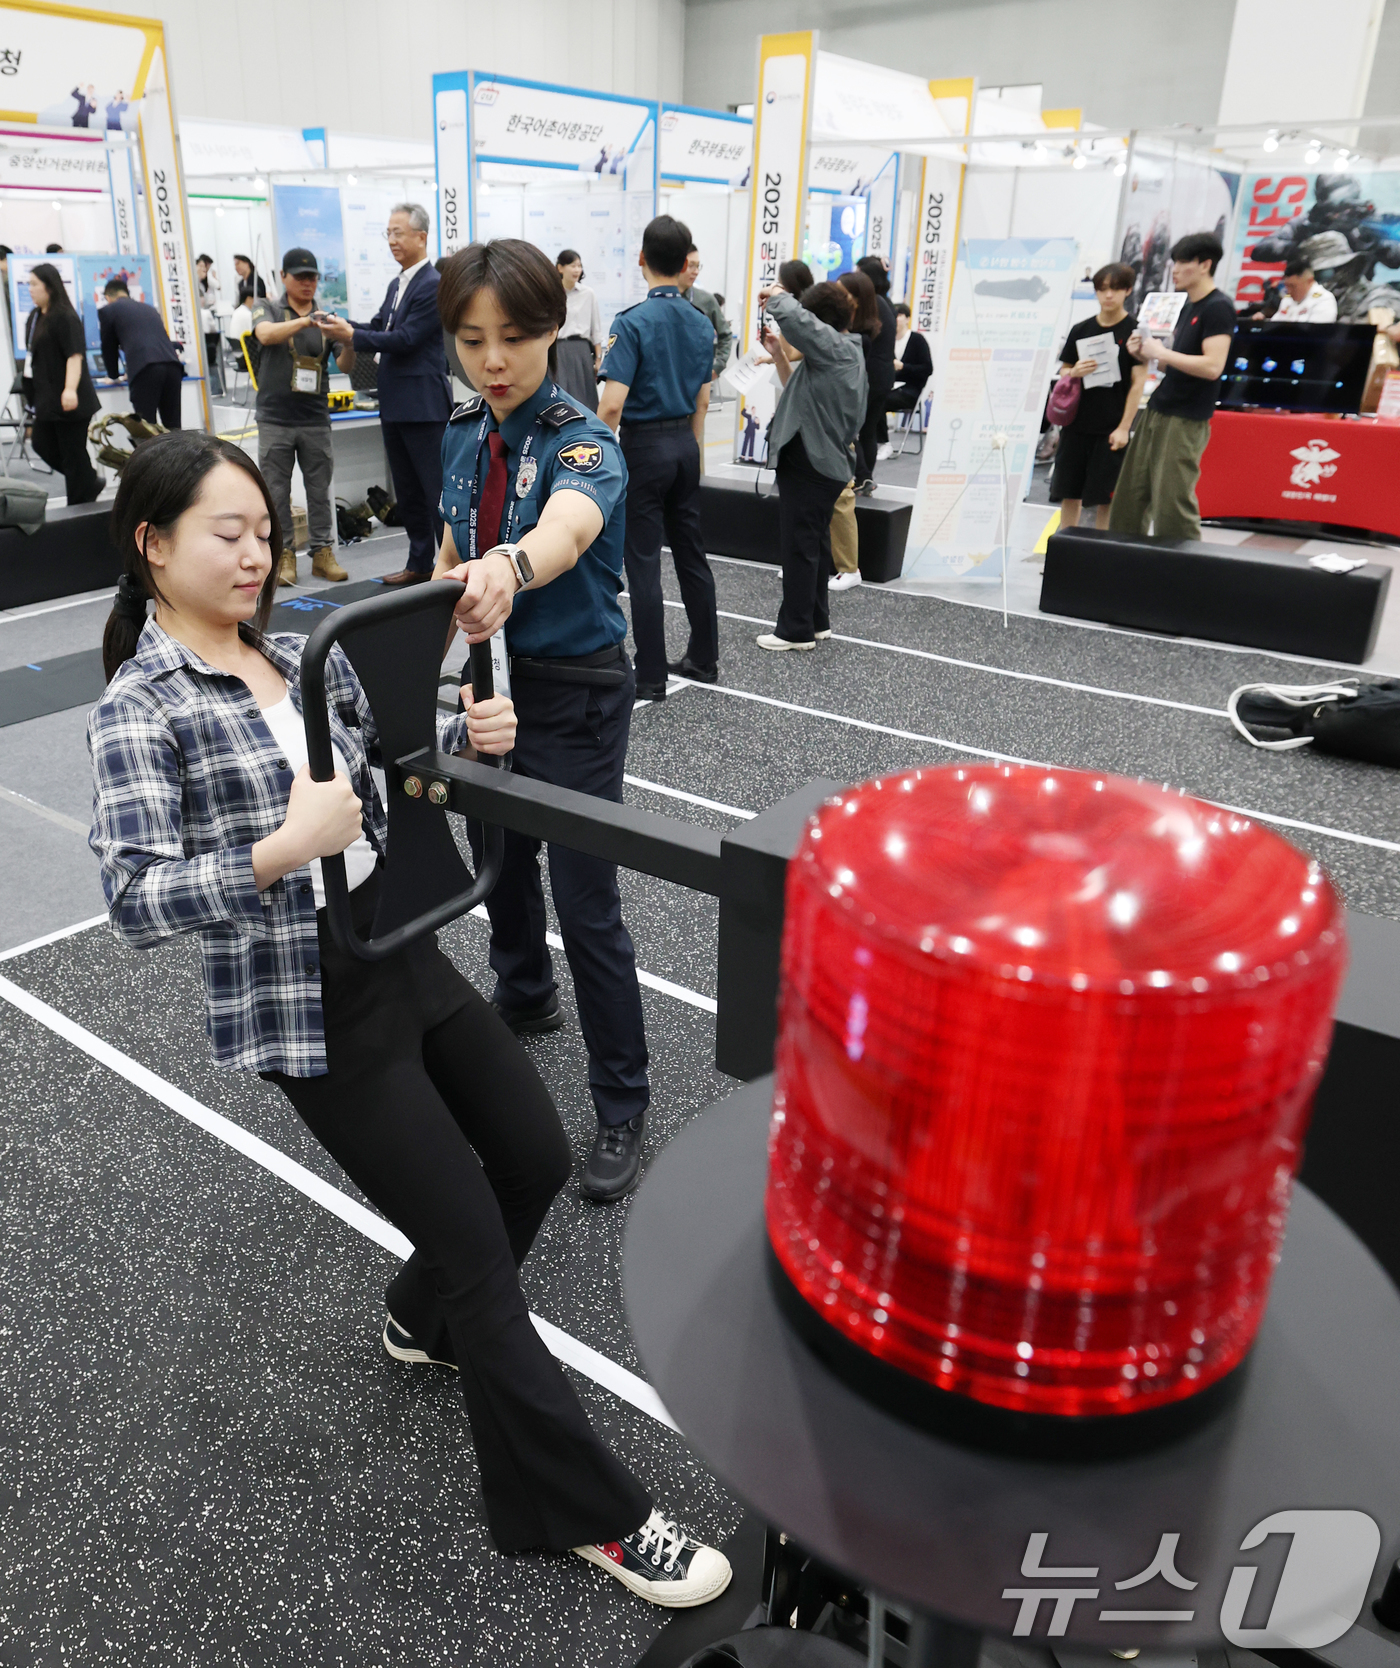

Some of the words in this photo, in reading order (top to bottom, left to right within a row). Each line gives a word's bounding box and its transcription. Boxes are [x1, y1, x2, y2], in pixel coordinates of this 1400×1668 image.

[506, 113, 603, 142] 한국어촌어항공단
[8, 154, 108, 174] 중앙선거관리위원
[688, 138, 746, 161] 한국부동산원
[117, 198, 129, 240] 2025
[154, 169, 172, 234] 2025
[444, 188, 458, 240] 2025
[763, 173, 782, 234] 2025
[925, 193, 944, 244] 2025
[871, 216, 883, 250] 2025
[917, 249, 939, 333] 공직박람회
[469, 508, 477, 527] 2025
